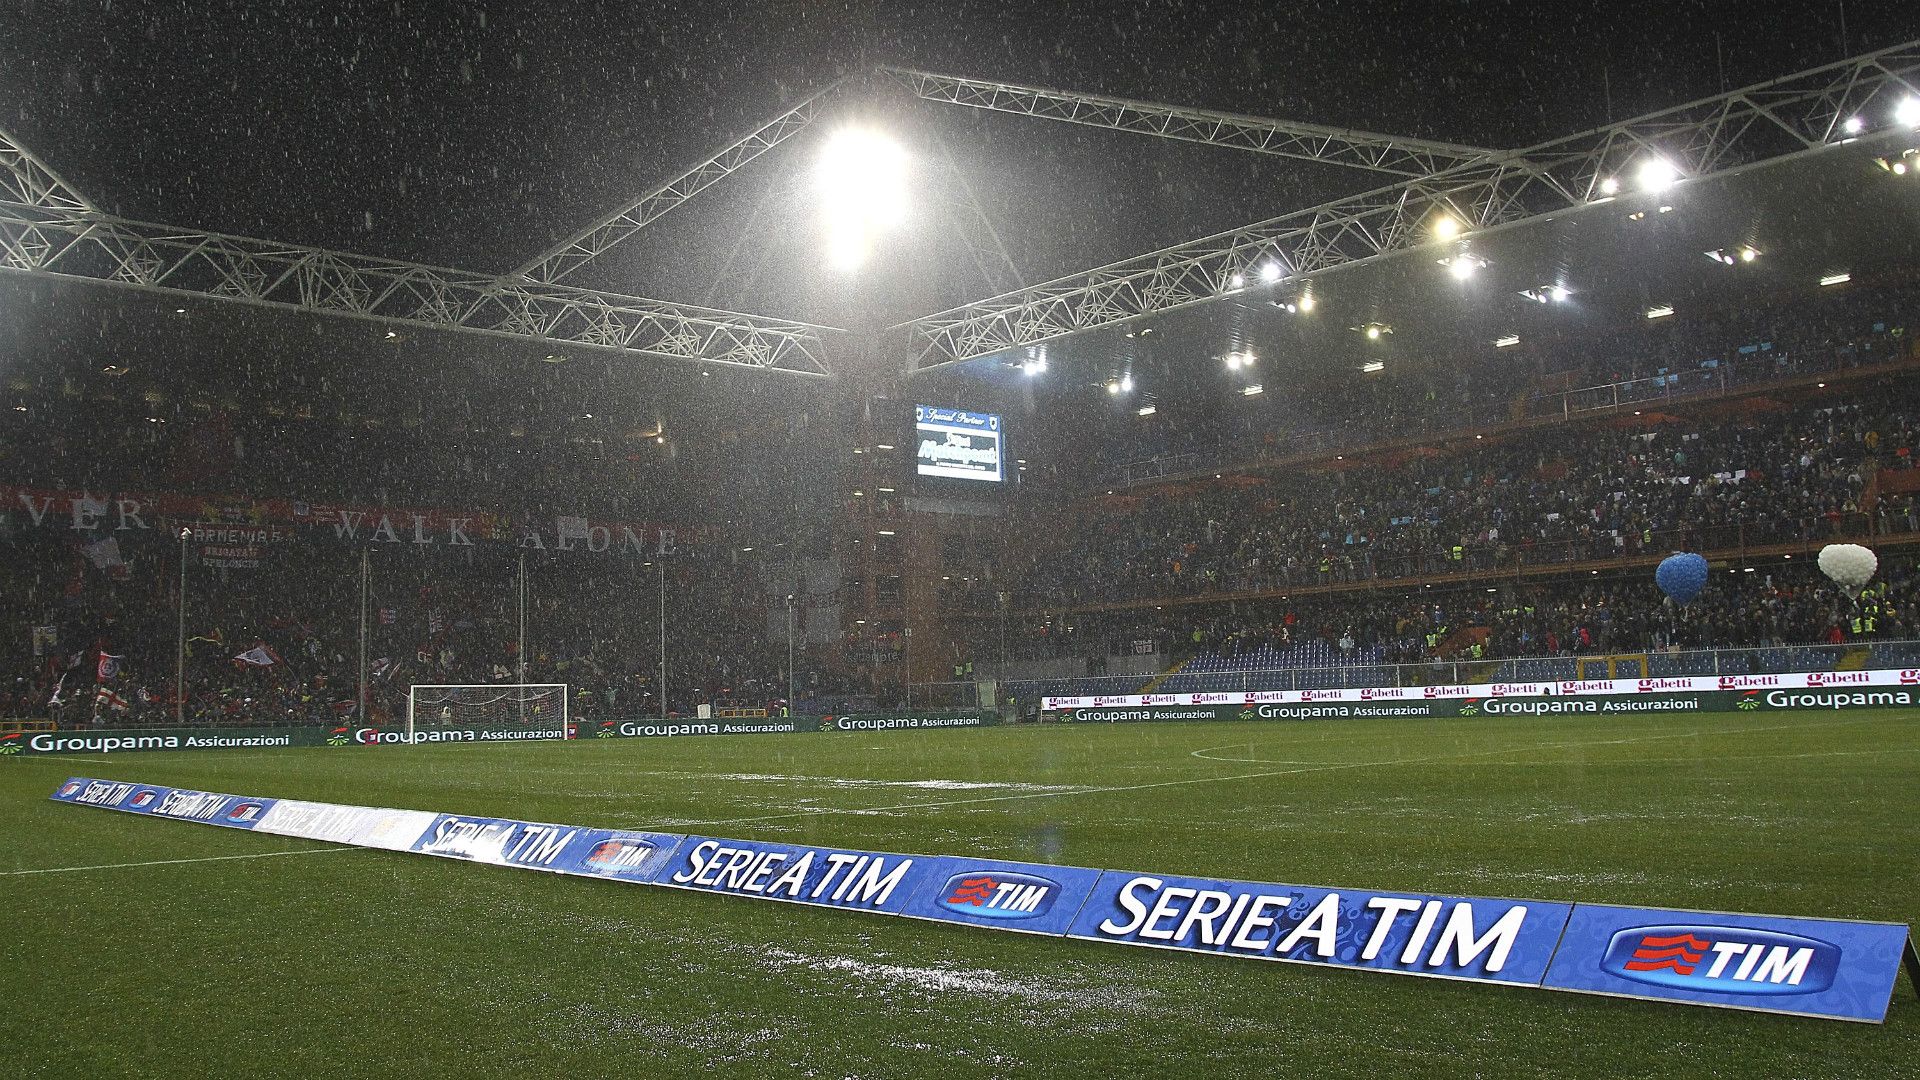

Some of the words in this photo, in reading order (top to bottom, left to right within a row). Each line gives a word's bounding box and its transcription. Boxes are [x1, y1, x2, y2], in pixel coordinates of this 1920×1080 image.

[926, 408, 957, 423] Special
[334, 510, 475, 546] WALK
[1638, 678, 1692, 693] gabetti
[1718, 675, 1778, 691] gabetti
[1807, 672, 1869, 688] gabetti
[1301, 690, 1342, 702] gabetti
[1360, 688, 1403, 701] gabetti
[1423, 685, 1470, 699] gabetti
[1491, 683, 1537, 698] gabetti
[1562, 681, 1613, 696] gabetti
[1049, 697, 1080, 708] gabetti
[1094, 696, 1126, 707] gabetti
[1141, 694, 1176, 706] gabetti
[1192, 693, 1228, 706] gabetti
[1245, 691, 1283, 703] gabetti
[1766, 690, 1911, 710] Groupama
[1258, 705, 1349, 720] Groupama
[1353, 705, 1429, 717] Assicurazioni
[1483, 698, 1597, 716] Groupama
[1602, 697, 1698, 711] Assicurazioni
[838, 716, 918, 730] Groupama
[921, 716, 980, 727] Assicurazioni
[1076, 709, 1150, 723] Groupama
[1153, 709, 1215, 720] Assicurazioni
[480, 729, 562, 741] Assicurazion
[620, 722, 719, 737] Groupama
[723, 722, 794, 733] Assicurazioni
[30, 734, 179, 753] Groupama
[185, 734, 290, 747] Assicurazioni
[505, 826, 578, 865] TIM
[612, 845, 651, 866] TIM
[673, 840, 787, 891] SERIE
[771, 851, 814, 896] A
[812, 854, 913, 905] TIM
[985, 882, 1049, 912] TIM
[1099, 877, 1292, 951] SERIE
[1275, 892, 1341, 957] A
[1353, 895, 1528, 972] TIM
[1708, 946, 1814, 986] TIM
